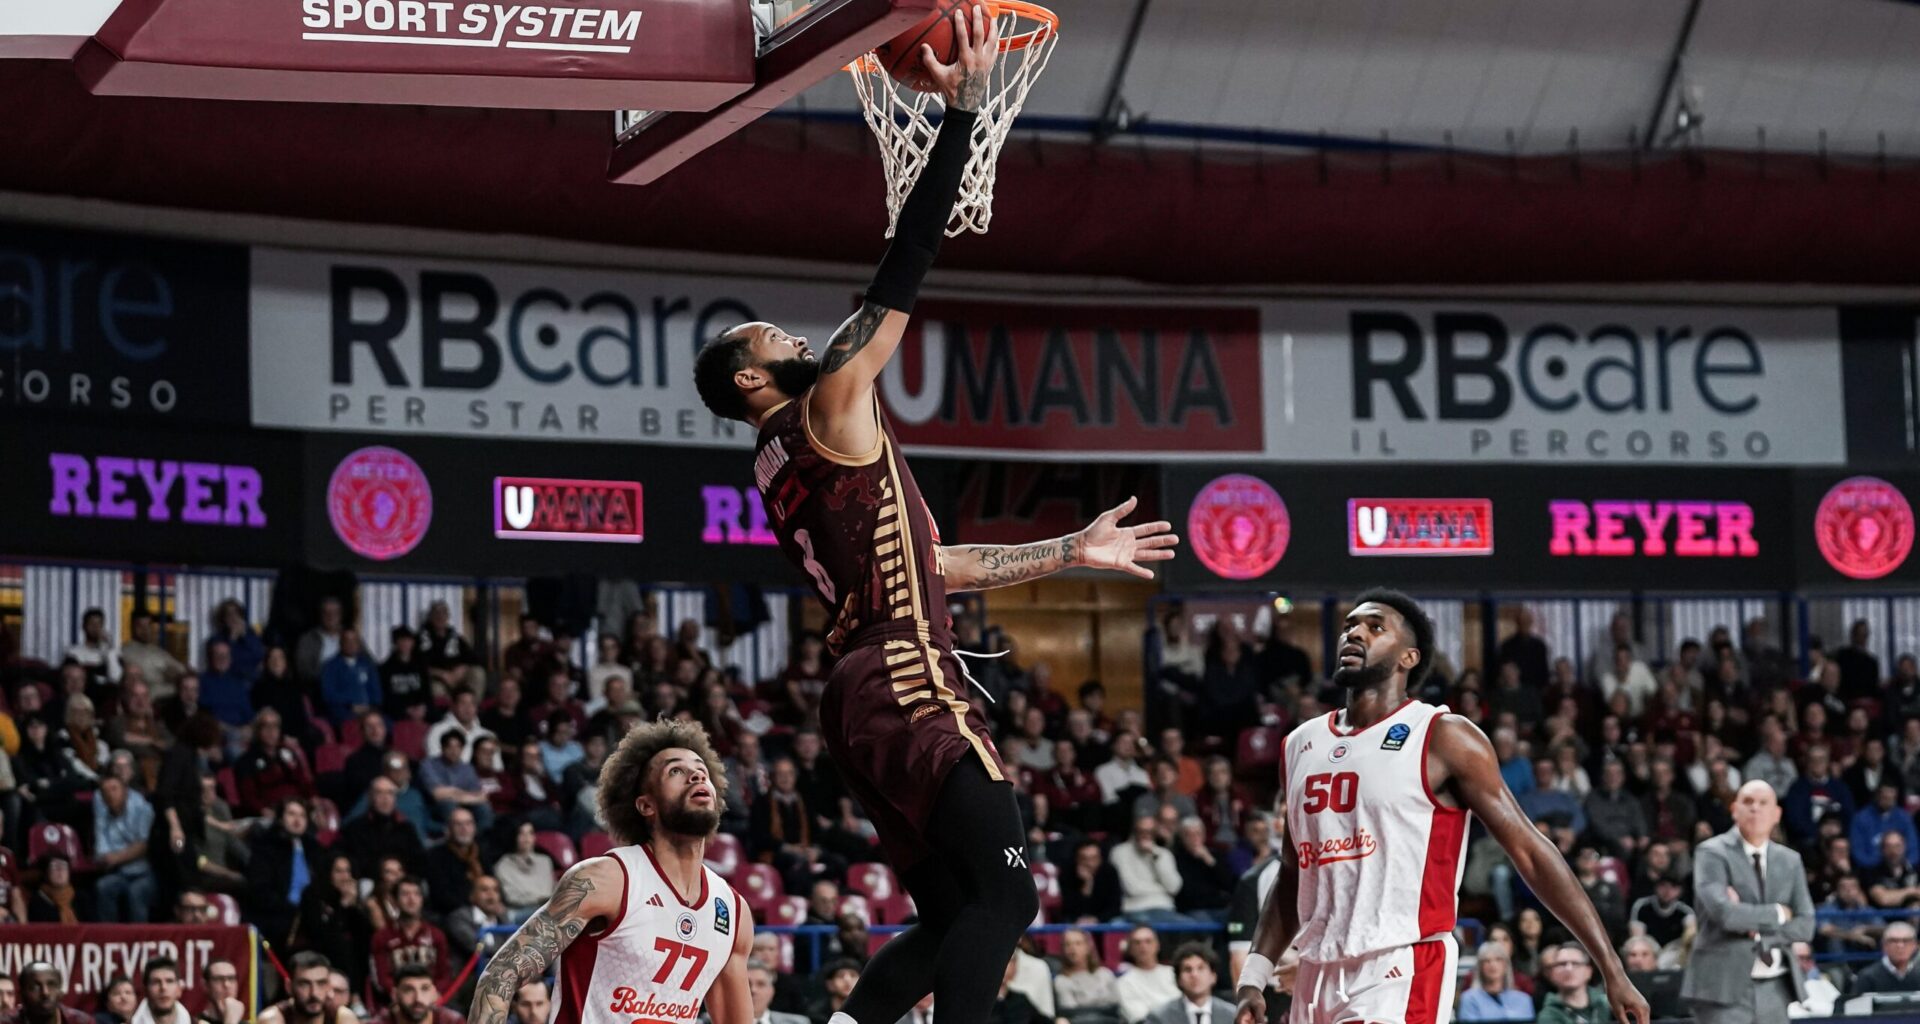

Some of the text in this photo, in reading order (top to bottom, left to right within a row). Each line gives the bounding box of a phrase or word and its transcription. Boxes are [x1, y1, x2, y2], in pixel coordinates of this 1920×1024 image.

[881, 321, 1234, 427] UMANA
[1349, 310, 1765, 421] RBcare
[0, 366, 177, 413] ORSO
[329, 394, 758, 440] PER STAR BEN
[1351, 429, 1772, 460] IL PERCORSO
[50, 452, 267, 528] REYER
[503, 485, 635, 533] UMANA
[1357, 506, 1480, 547] UMANA
[1548, 500, 1759, 557] REYER
[977, 546, 1058, 570] Bowman
[1303, 771, 1360, 815] 50
[651, 936, 709, 992] 77
